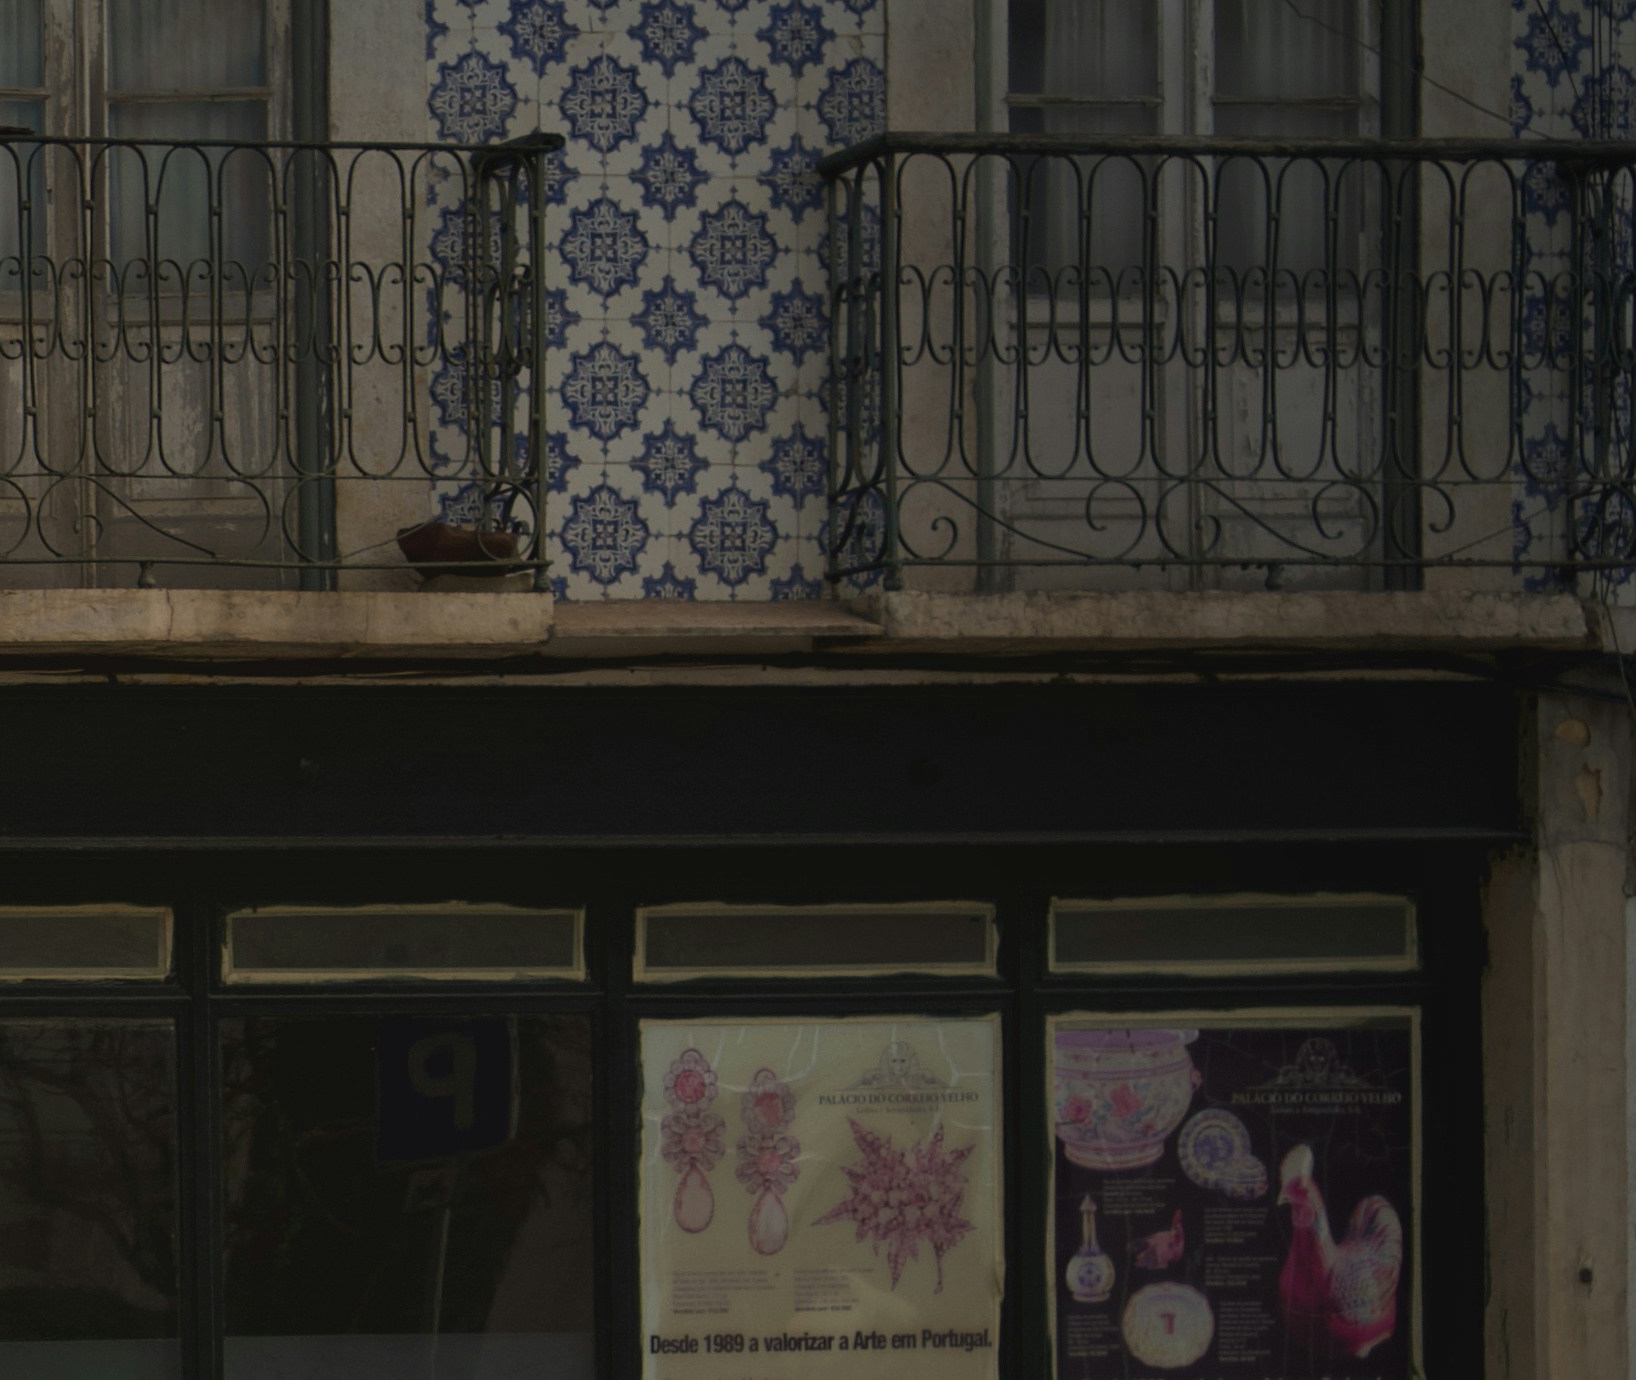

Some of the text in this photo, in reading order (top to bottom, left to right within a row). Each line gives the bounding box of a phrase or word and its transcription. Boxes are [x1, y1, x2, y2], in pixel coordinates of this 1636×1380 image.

[869, 1093, 886, 1104] DO
[1285, 1091, 1303, 1103] DO
[1361, 1091, 1402, 1103] VELHO
[650, 1328, 993, 1354] Desde 1989 a valorizar a Arte em Portugal.
